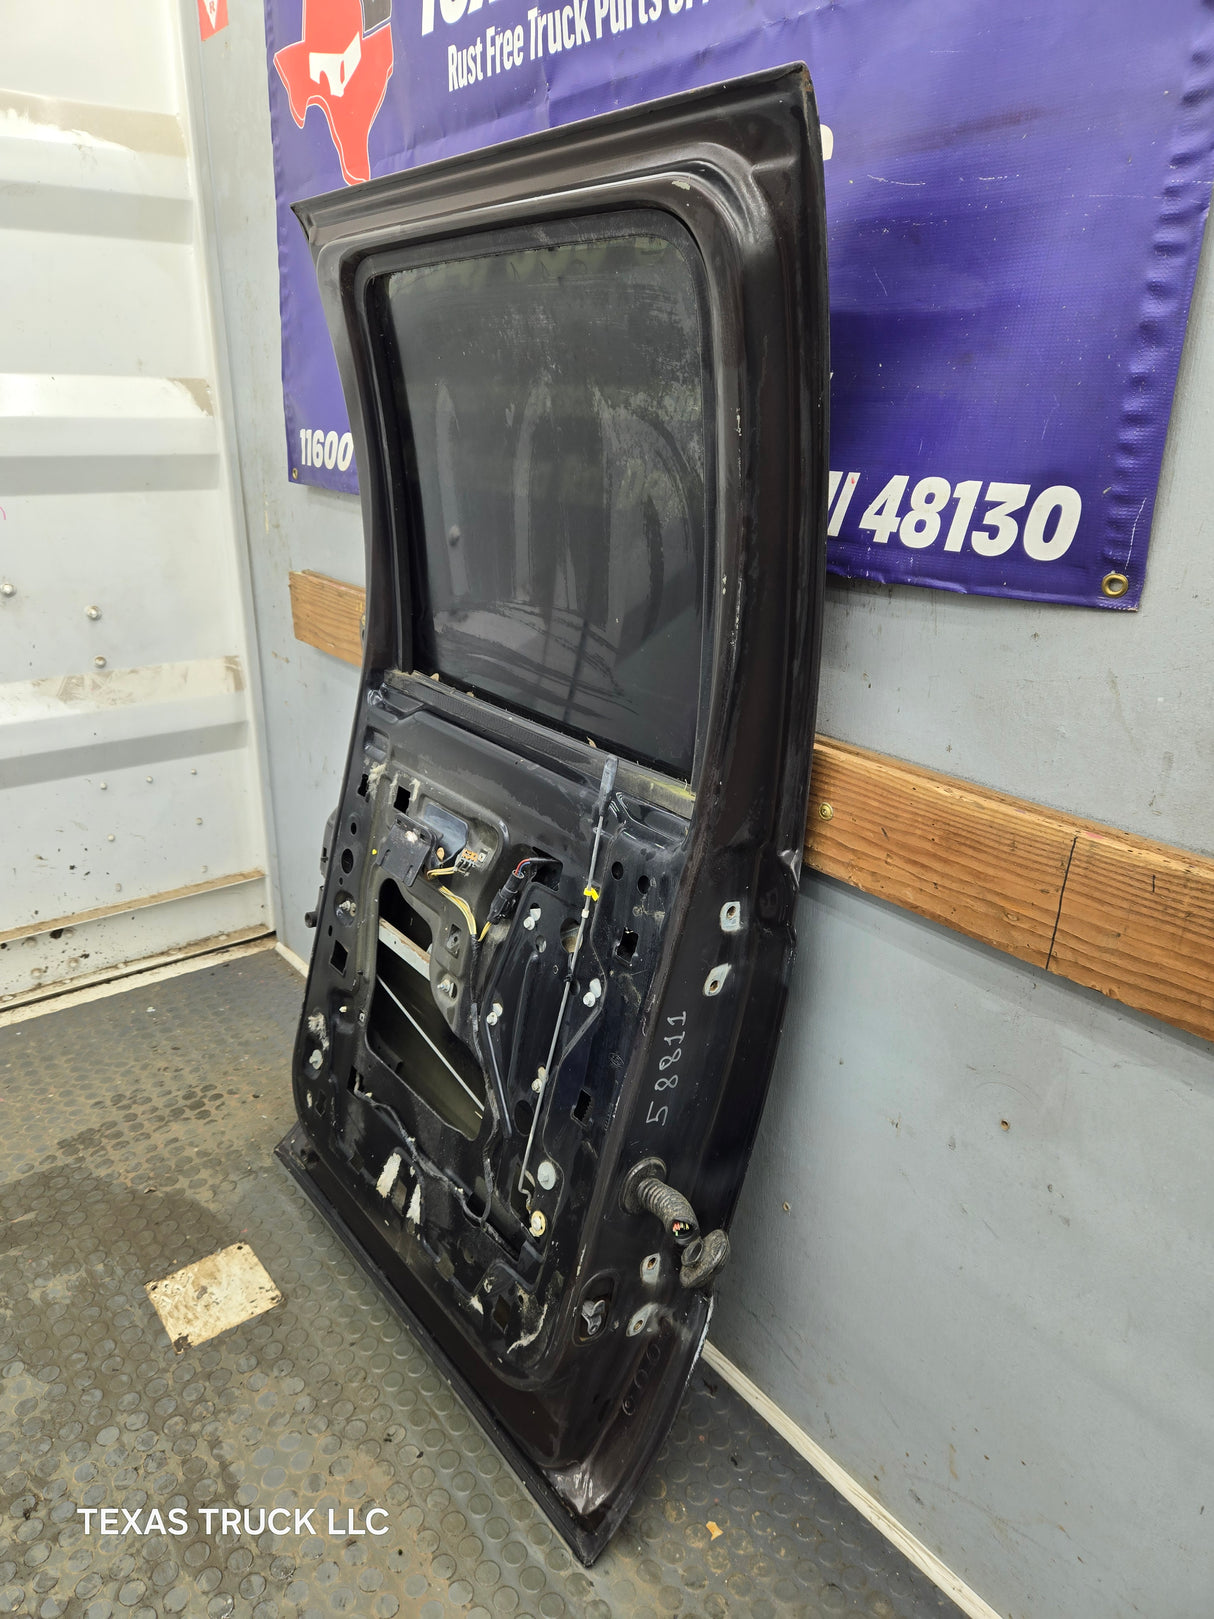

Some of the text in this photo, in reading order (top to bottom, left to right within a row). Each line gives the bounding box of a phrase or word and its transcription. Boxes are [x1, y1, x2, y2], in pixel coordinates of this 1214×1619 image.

[447, 44, 484, 92] Rust
[486, 24, 524, 77] Free
[527, 0, 591, 61] Truck
[299, 428, 1082, 562] 11600 I 48130
[645, 1010, 687, 1127] 58811
